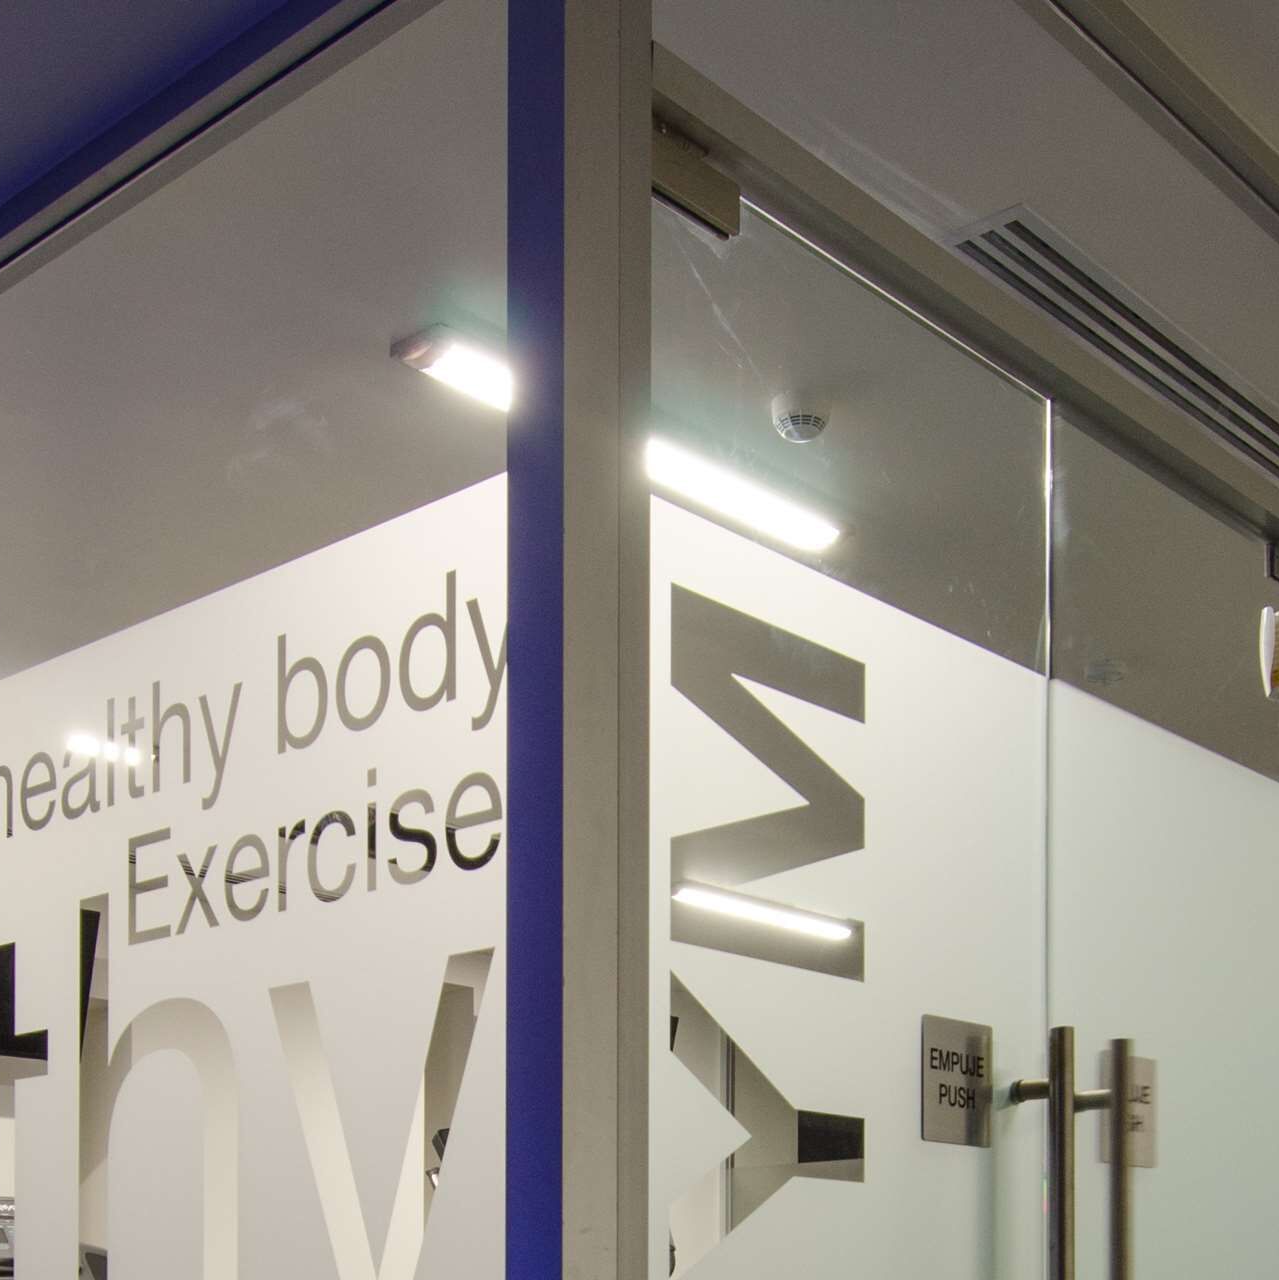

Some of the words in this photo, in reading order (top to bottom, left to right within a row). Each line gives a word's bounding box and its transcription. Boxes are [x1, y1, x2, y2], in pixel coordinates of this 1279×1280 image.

[277, 568, 508, 756] body
[127, 766, 504, 946] Exercise
[929, 1046, 985, 1079] EMPUJE
[937, 1082, 977, 1111] PUSH
